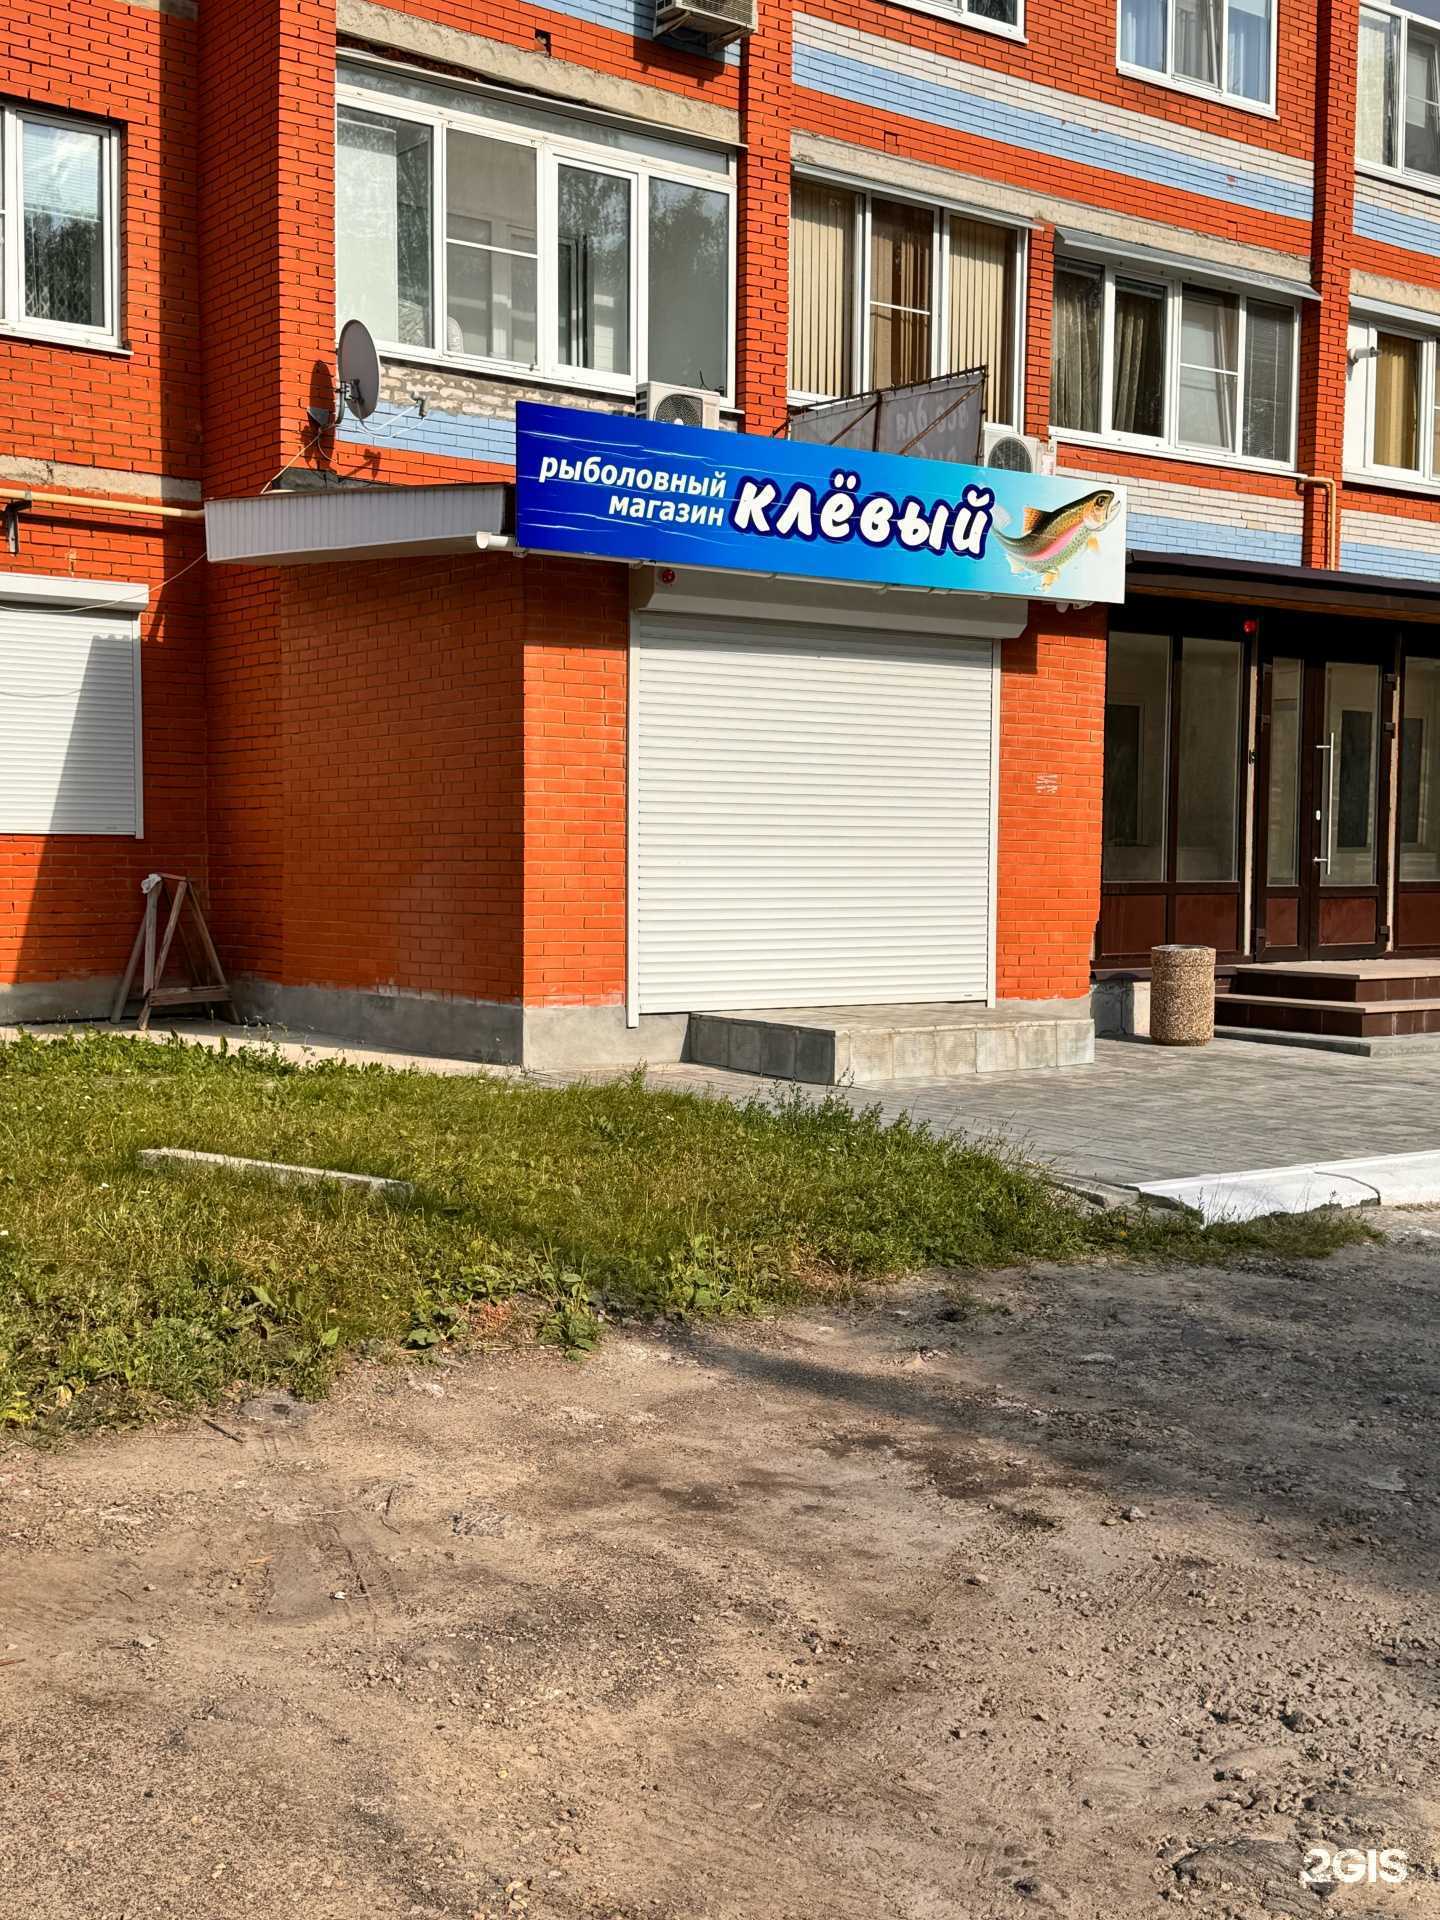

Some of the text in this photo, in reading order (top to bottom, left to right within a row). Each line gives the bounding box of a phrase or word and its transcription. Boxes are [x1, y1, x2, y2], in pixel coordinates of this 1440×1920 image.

[538, 456, 727, 498] рыболовный
[608, 495, 725, 527] магазин
[733, 473, 990, 555] клёвый
